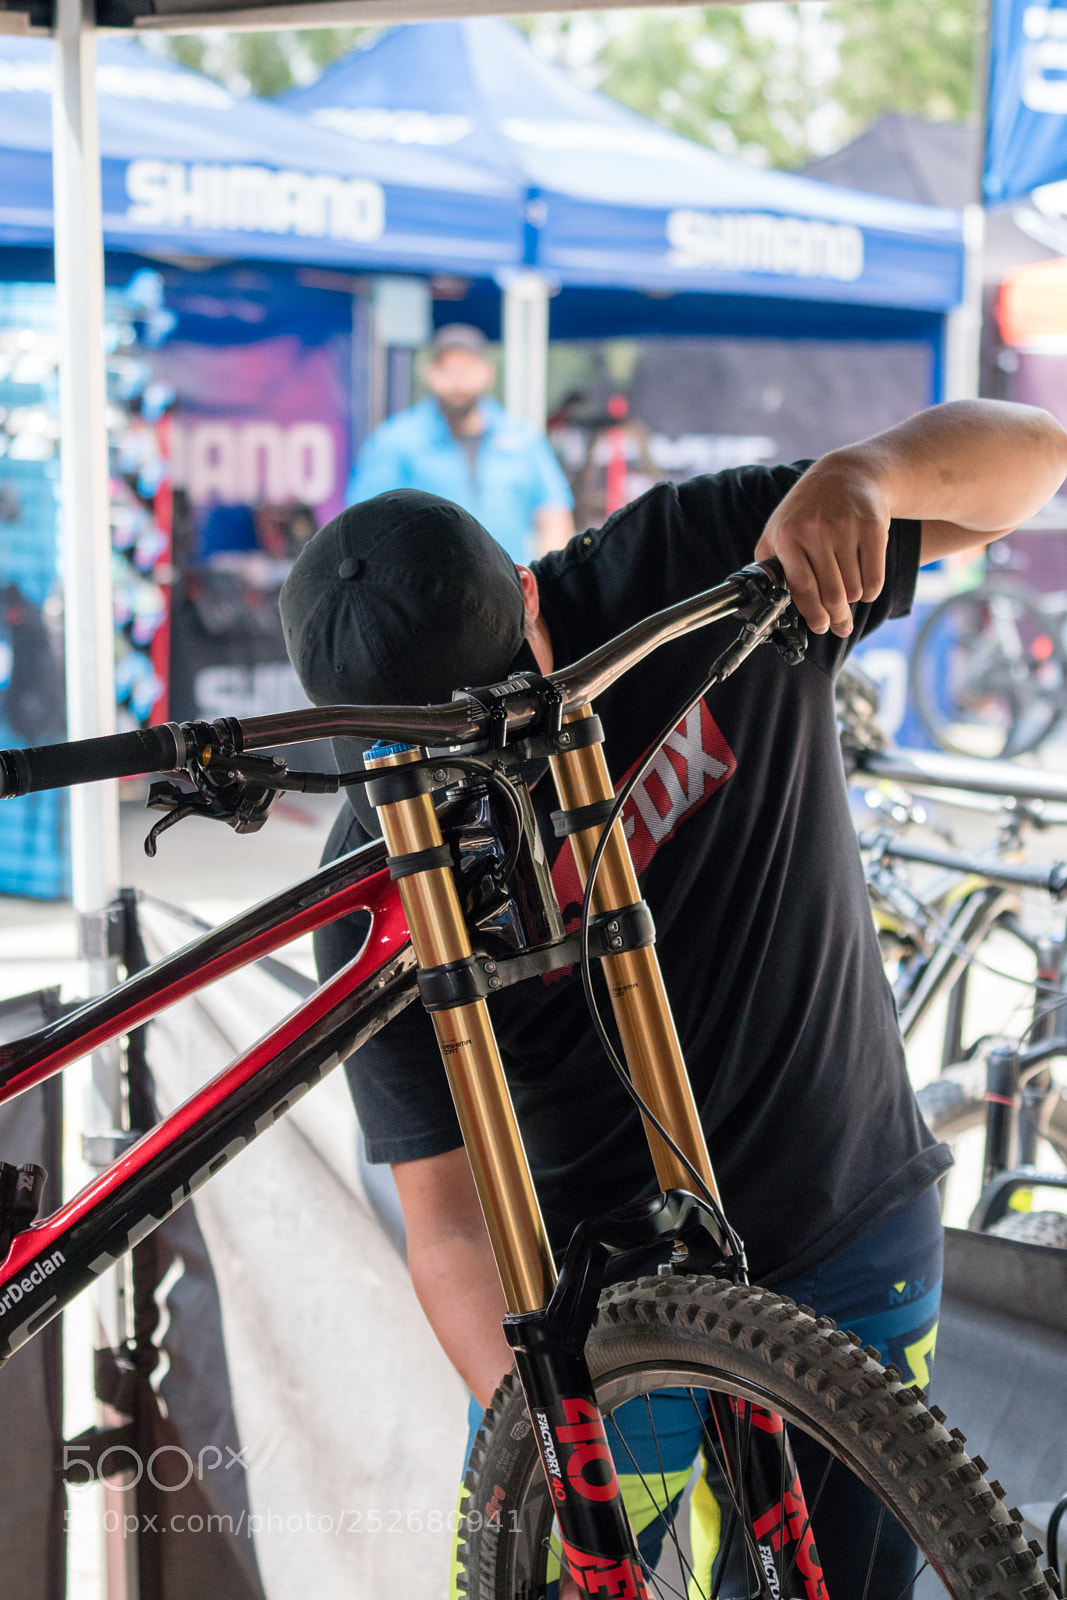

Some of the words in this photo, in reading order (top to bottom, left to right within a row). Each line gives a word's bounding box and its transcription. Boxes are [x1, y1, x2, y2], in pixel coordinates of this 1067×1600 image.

[126, 160, 386, 243] SHIMANO
[536, 1412, 562, 1478] FACTORY
[552, 1477, 566, 1500] 40
